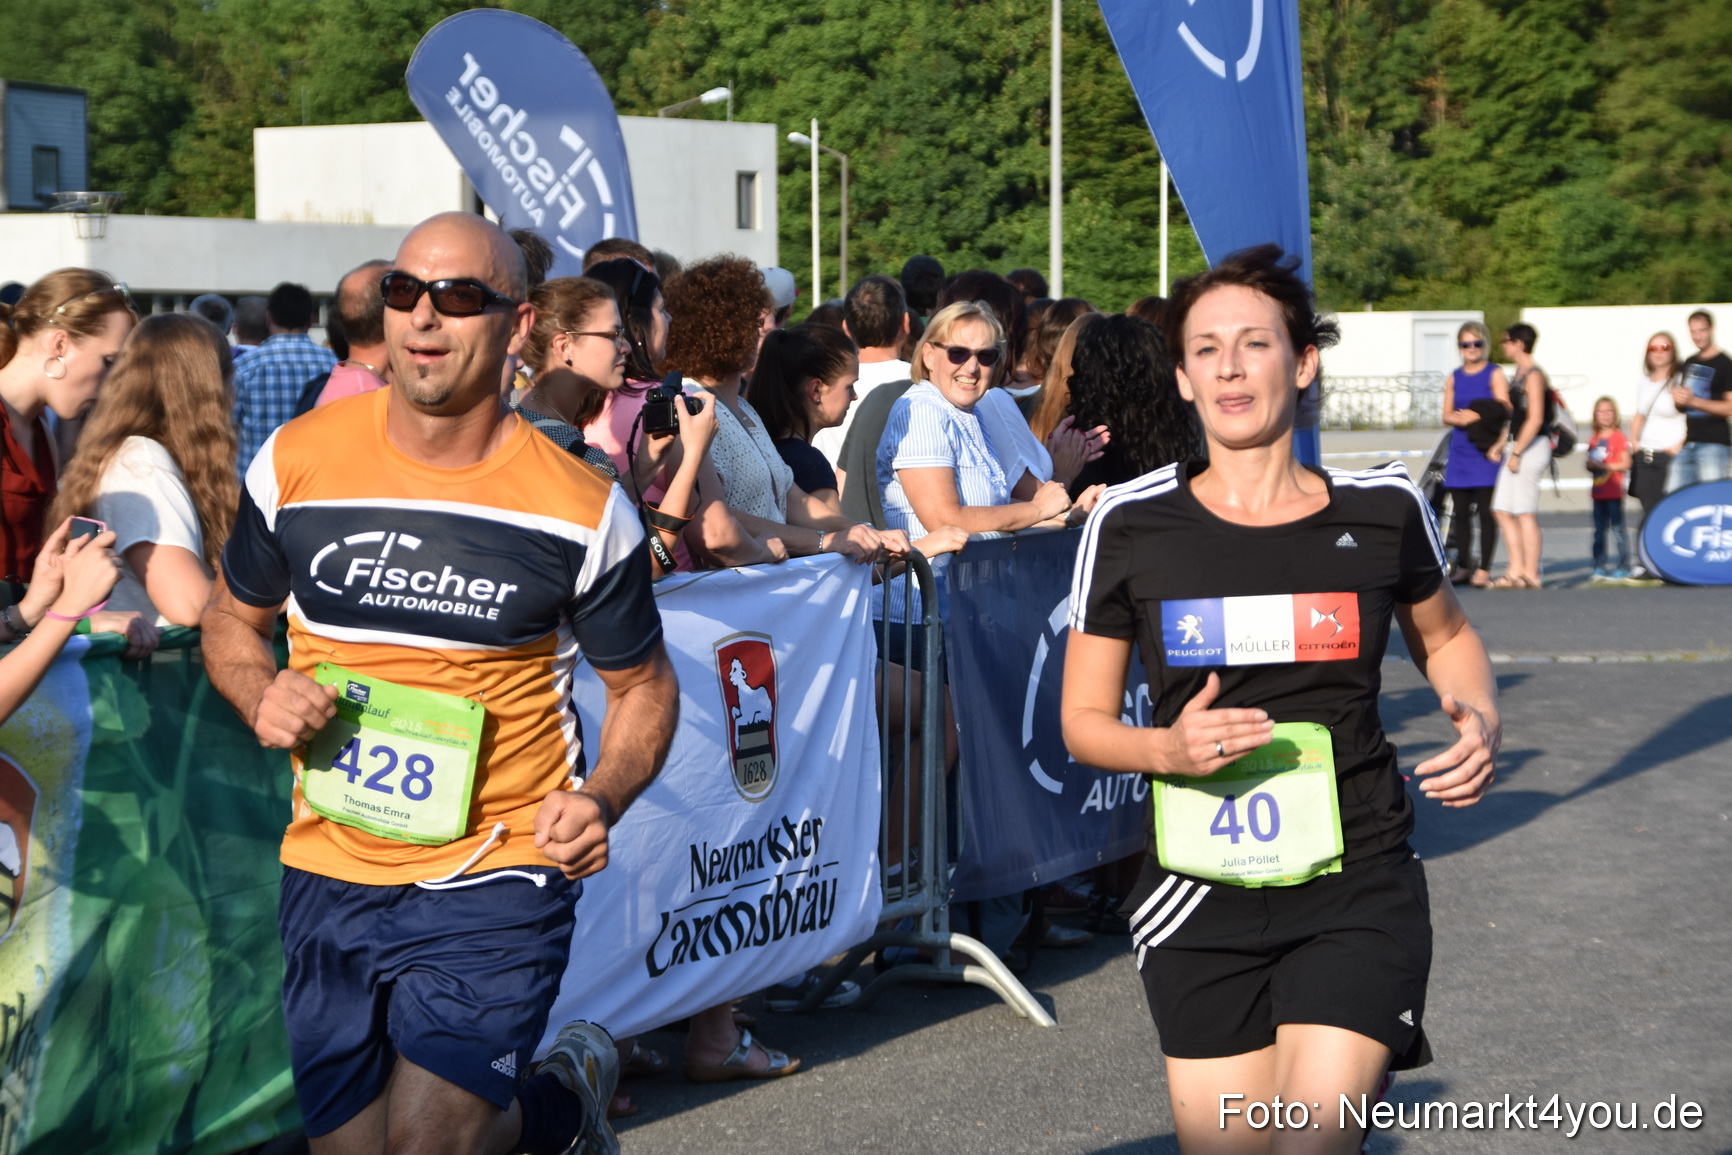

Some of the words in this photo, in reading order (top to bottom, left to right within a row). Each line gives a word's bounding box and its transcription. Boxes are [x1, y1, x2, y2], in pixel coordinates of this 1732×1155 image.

[650, 536, 671, 565] SONY
[1690, 526, 1732, 550] Fis
[1703, 549, 1732, 562] AU
[343, 557, 518, 604] Fischer
[358, 592, 500, 621] AUTOMOBILE
[1168, 648, 1223, 657] PEUGEOT
[390, 716, 423, 732] 2015
[331, 736, 435, 801] 428
[743, 760, 767, 785] 1628
[1080, 772, 1151, 815] AUTO
[343, 794, 382, 813] Thomas
[383, 806, 411, 820] Emra
[1209, 791, 1281, 844] 40
[1221, 857, 1246, 868] Julia
[1248, 854, 1280, 865] Pöllet
[491, 1060, 517, 1079] adida
